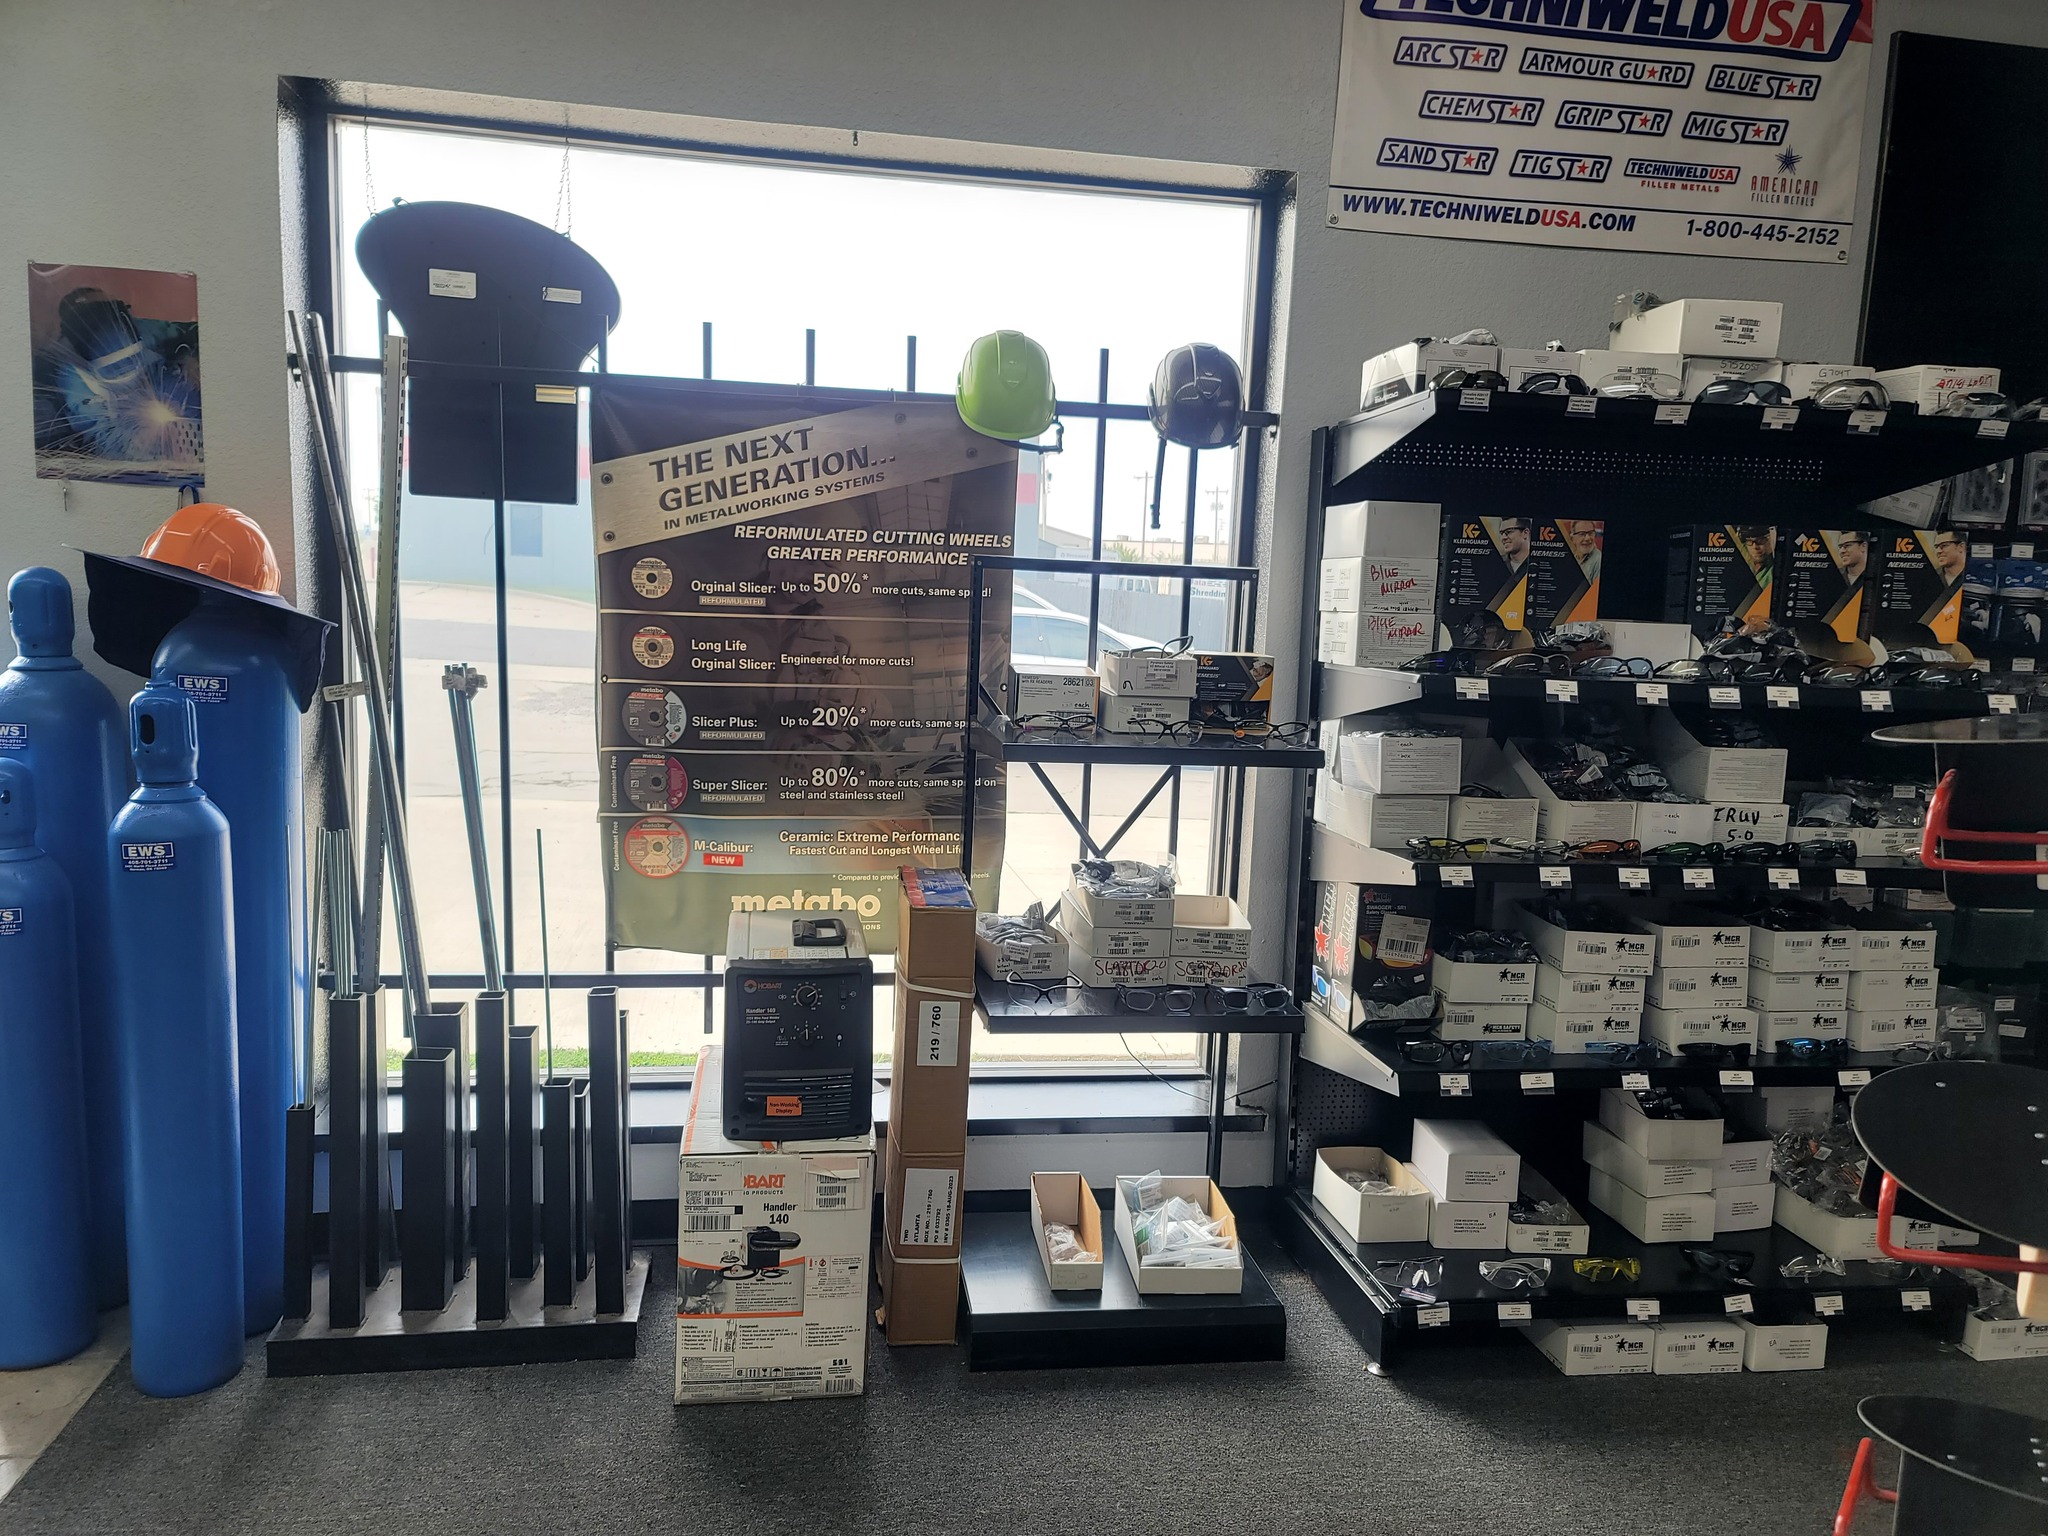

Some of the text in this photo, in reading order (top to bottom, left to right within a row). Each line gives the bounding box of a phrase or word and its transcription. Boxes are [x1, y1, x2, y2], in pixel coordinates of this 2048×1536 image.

[1525, 53, 1614, 77] ARMOUR
[1630, 161, 1734, 182] TECHNIWELDUSA
[1641, 180, 1721, 193] FILLER METALS
[1751, 175, 1819, 197] AMERICAN
[1751, 192, 1815, 207] FILLER METALS
[1343, 193, 1636, 233] WWW.TECHNIWELDUSA.COM
[1687, 218, 1840, 246] 1-800-445-2152
[649, 425, 814, 483] THE NEXT
[664, 472, 885, 530] IN METALWORKING SYSTEMS
[734, 525, 1012, 548] REFORMULATED CUTTING WHEELS
[767, 546, 969, 567] GREATER PERFORMANCE
[1455, 547, 1491, 555] NEMESIS
[1530, 550, 1566, 558] NEMESIS
[1794, 561, 1829, 569] NEMESIS
[1887, 561, 1925, 569] NEMESIS
[691, 580, 735, 595] Orginal
[738, 581, 776, 595] Slicer:
[781, 581, 796, 594] Up
[799, 583, 810, 593] to
[872, 586, 899, 596] more
[901, 586, 926, 597] cuts,
[928, 587, 955, 597] same
[701, 597, 764, 606] REFORMULATED
[691, 639, 747, 653] Long Life
[691, 654, 914, 671] Orginal Slicer: Engineered for more cuts!
[184, 677, 220, 689] EWS
[1063, 677, 1084, 687] 28621
[692, 716, 727, 728] Slicer
[729, 716, 758, 728] Plus:
[780, 716, 795, 727] Up
[798, 716, 809, 726] to
[870, 719, 896, 727] more
[899, 719, 923, 729] cuts,
[925, 720, 952, 728] same
[702, 732, 763, 740] REFORMULATED
[692, 780, 727, 791] Super
[731, 779, 768, 791] Slicer:
[780, 777, 795, 788] Up
[798, 777, 808, 787] to
[868, 779, 895, 788] more
[897, 778, 921, 788] cuts,
[923, 779, 949, 788] same
[951, 777, 980, 789] spd
[984, 779, 996, 788] on
[780, 790, 904, 801] steel and stainless steel!
[1713, 807, 1760, 825] IRUV
[1726, 828, 1754, 842] 5.0
[694, 831, 960, 853] M-Calibur: Ceramic: Extreme Performanc
[128, 845, 166, 857] EWS
[789, 845, 960, 856] Fastest Cut and Longest Wheel Lif
[711, 855, 735, 865] NEW
[1628, 942, 1645, 950] MCR
[1911, 939, 1926, 947] MCR
[1619, 980, 1635, 988] MCR
[1722, 976, 1737, 984] MCR
[1914, 977, 1929, 985] MCR
[931, 1005, 941, 1028] 760
[1614, 1020, 1630, 1028] MCR
[1731, 1021, 1747, 1029] MCR
[930, 1038, 939, 1061] 219
[763, 1202, 796, 1212] Handler
[769, 1213, 789, 1225] 140
[1719, 1341, 1735, 1349] MCR
